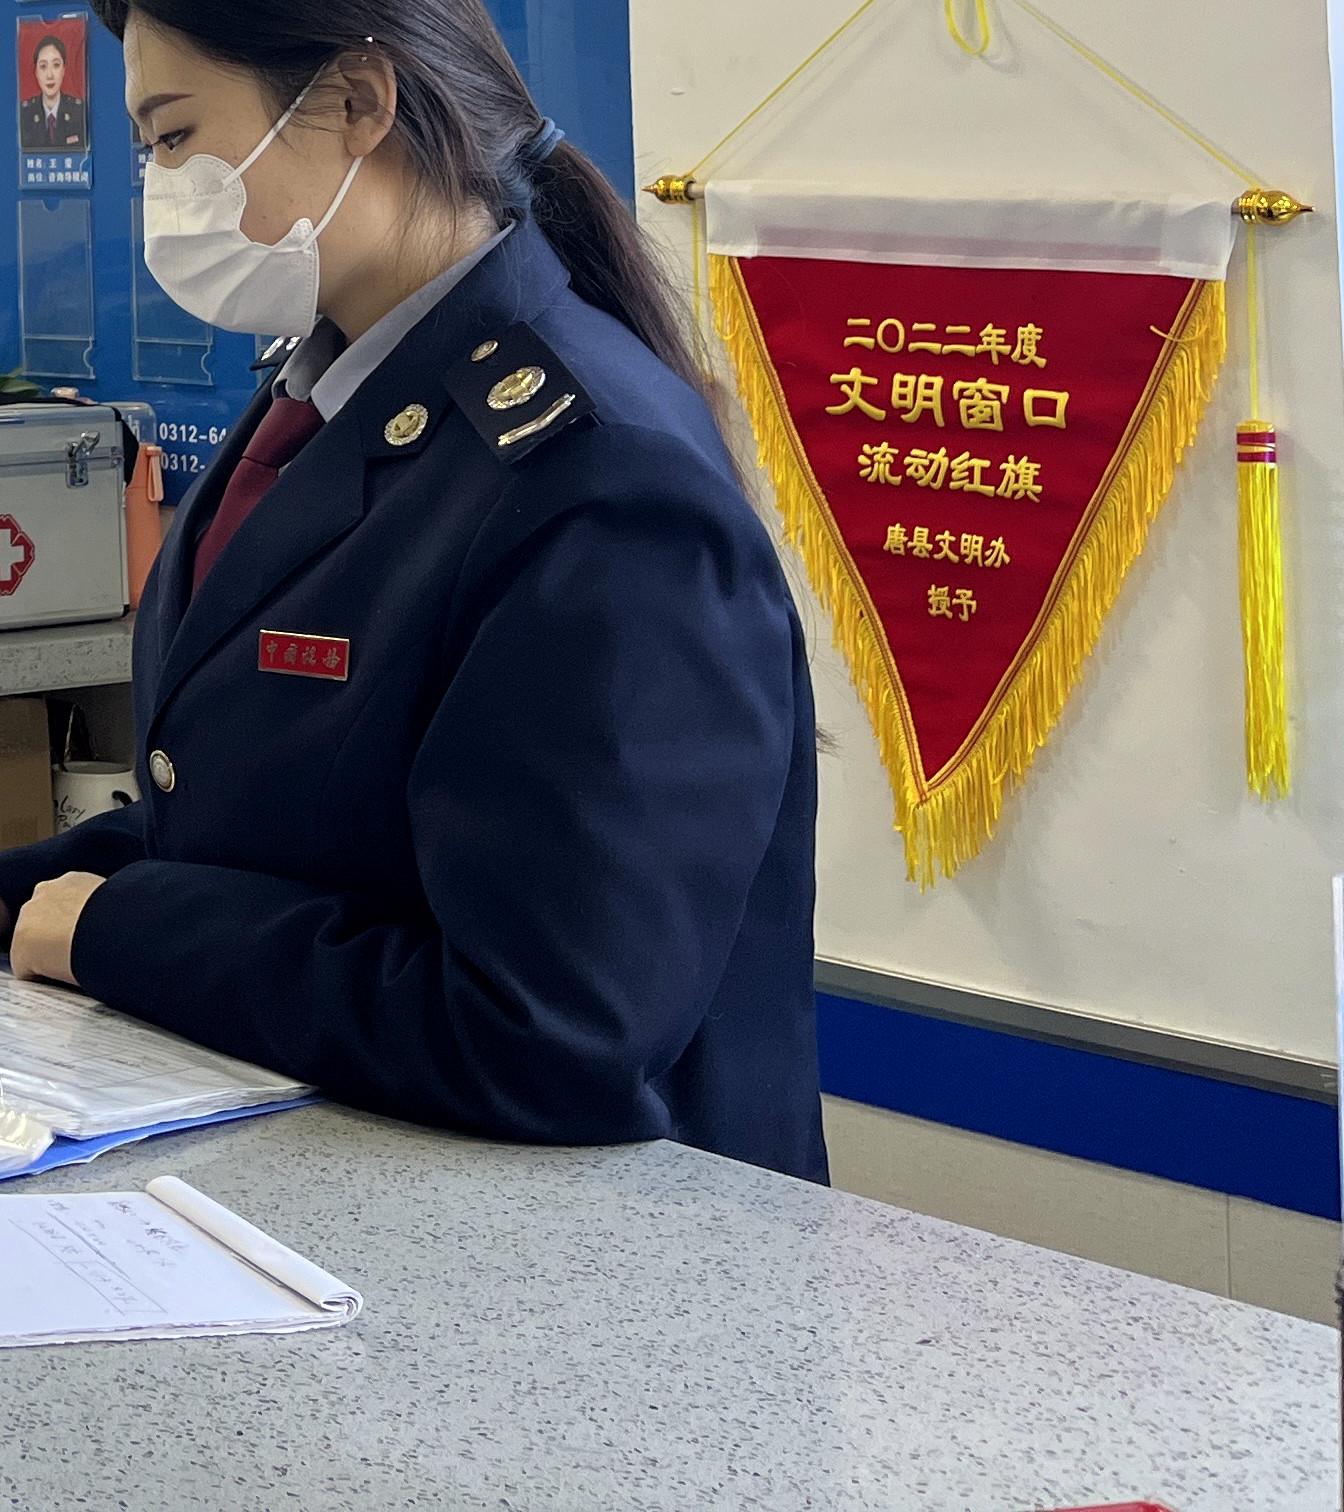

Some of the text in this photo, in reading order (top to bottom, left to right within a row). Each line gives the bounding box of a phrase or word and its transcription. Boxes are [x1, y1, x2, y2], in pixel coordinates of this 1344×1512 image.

[843, 318, 1047, 369] 二〇二二年度
[825, 368, 1070, 431] 文明窗口
[857, 442, 1044, 502] 流动红旗
[883, 524, 1011, 568] 唐县文明办
[927, 584, 978, 622] 授予
